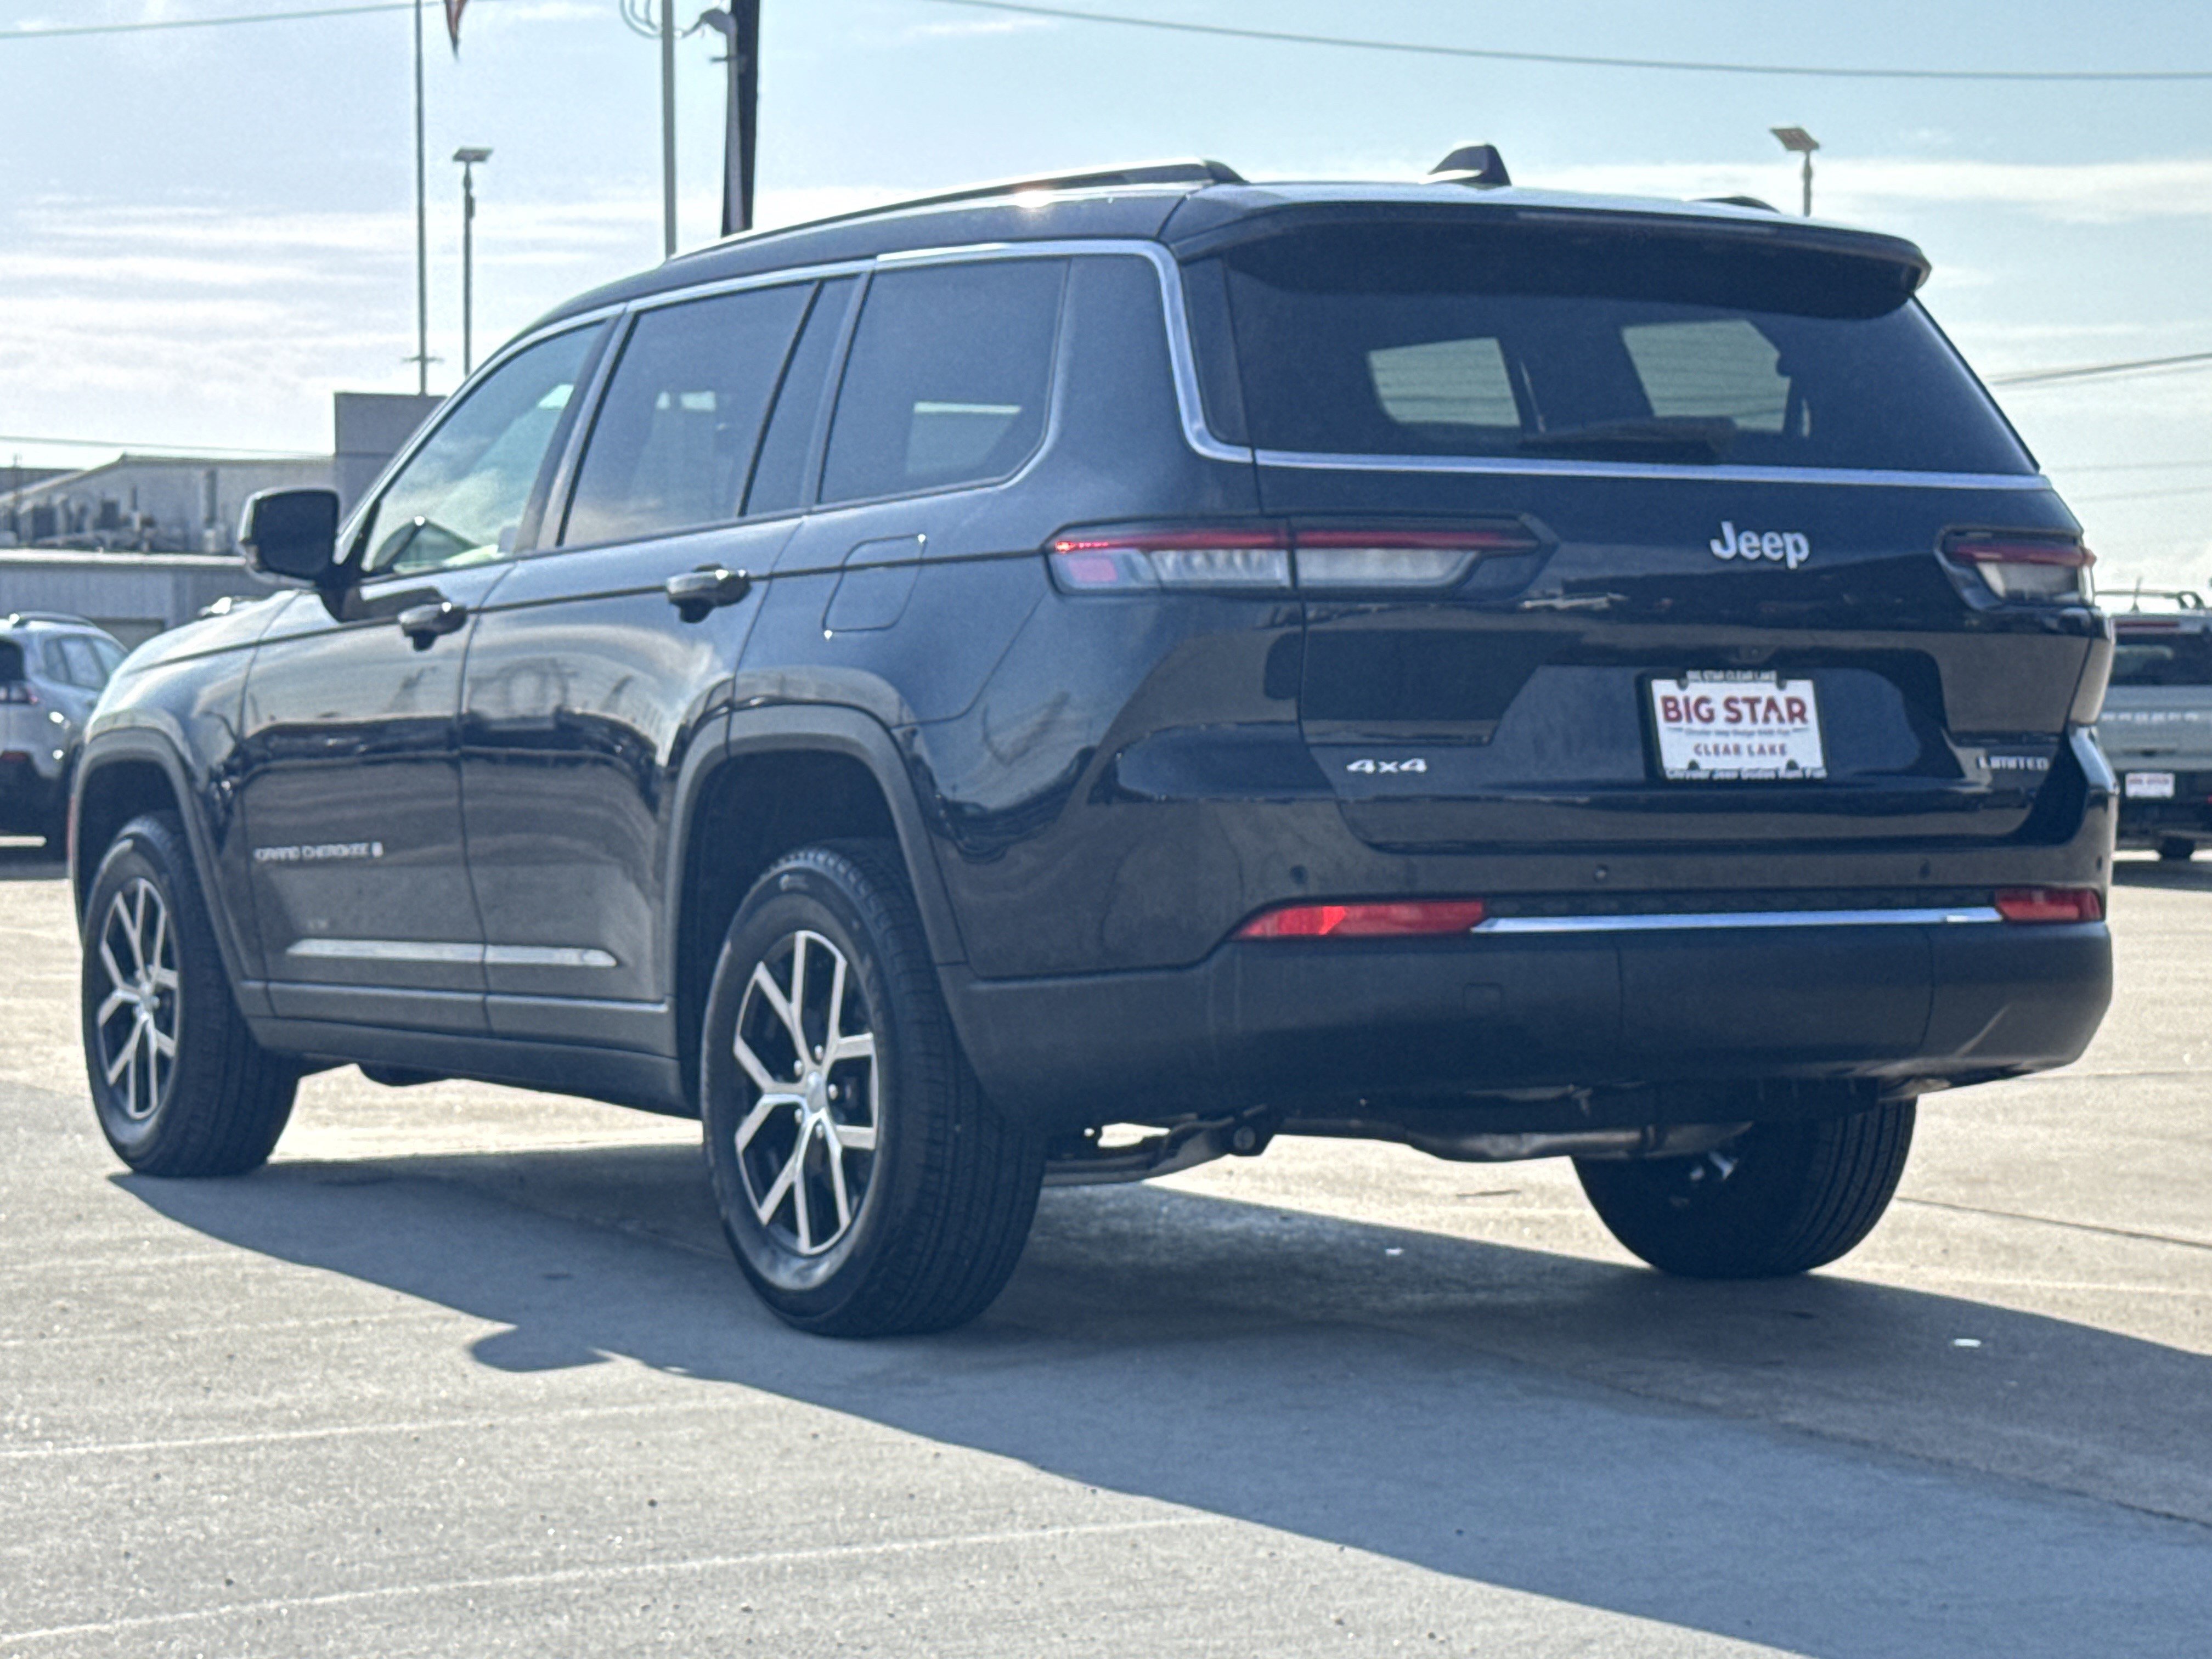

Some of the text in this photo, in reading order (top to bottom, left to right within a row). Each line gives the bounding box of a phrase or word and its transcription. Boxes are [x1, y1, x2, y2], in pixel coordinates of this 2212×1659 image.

[1710, 521, 1809, 569] Jeep
[1661, 696, 1808, 725] BIG STAR
[1694, 743, 1788, 757] CLEAR LAKE
[1346, 758, 1427, 774] 4x4
